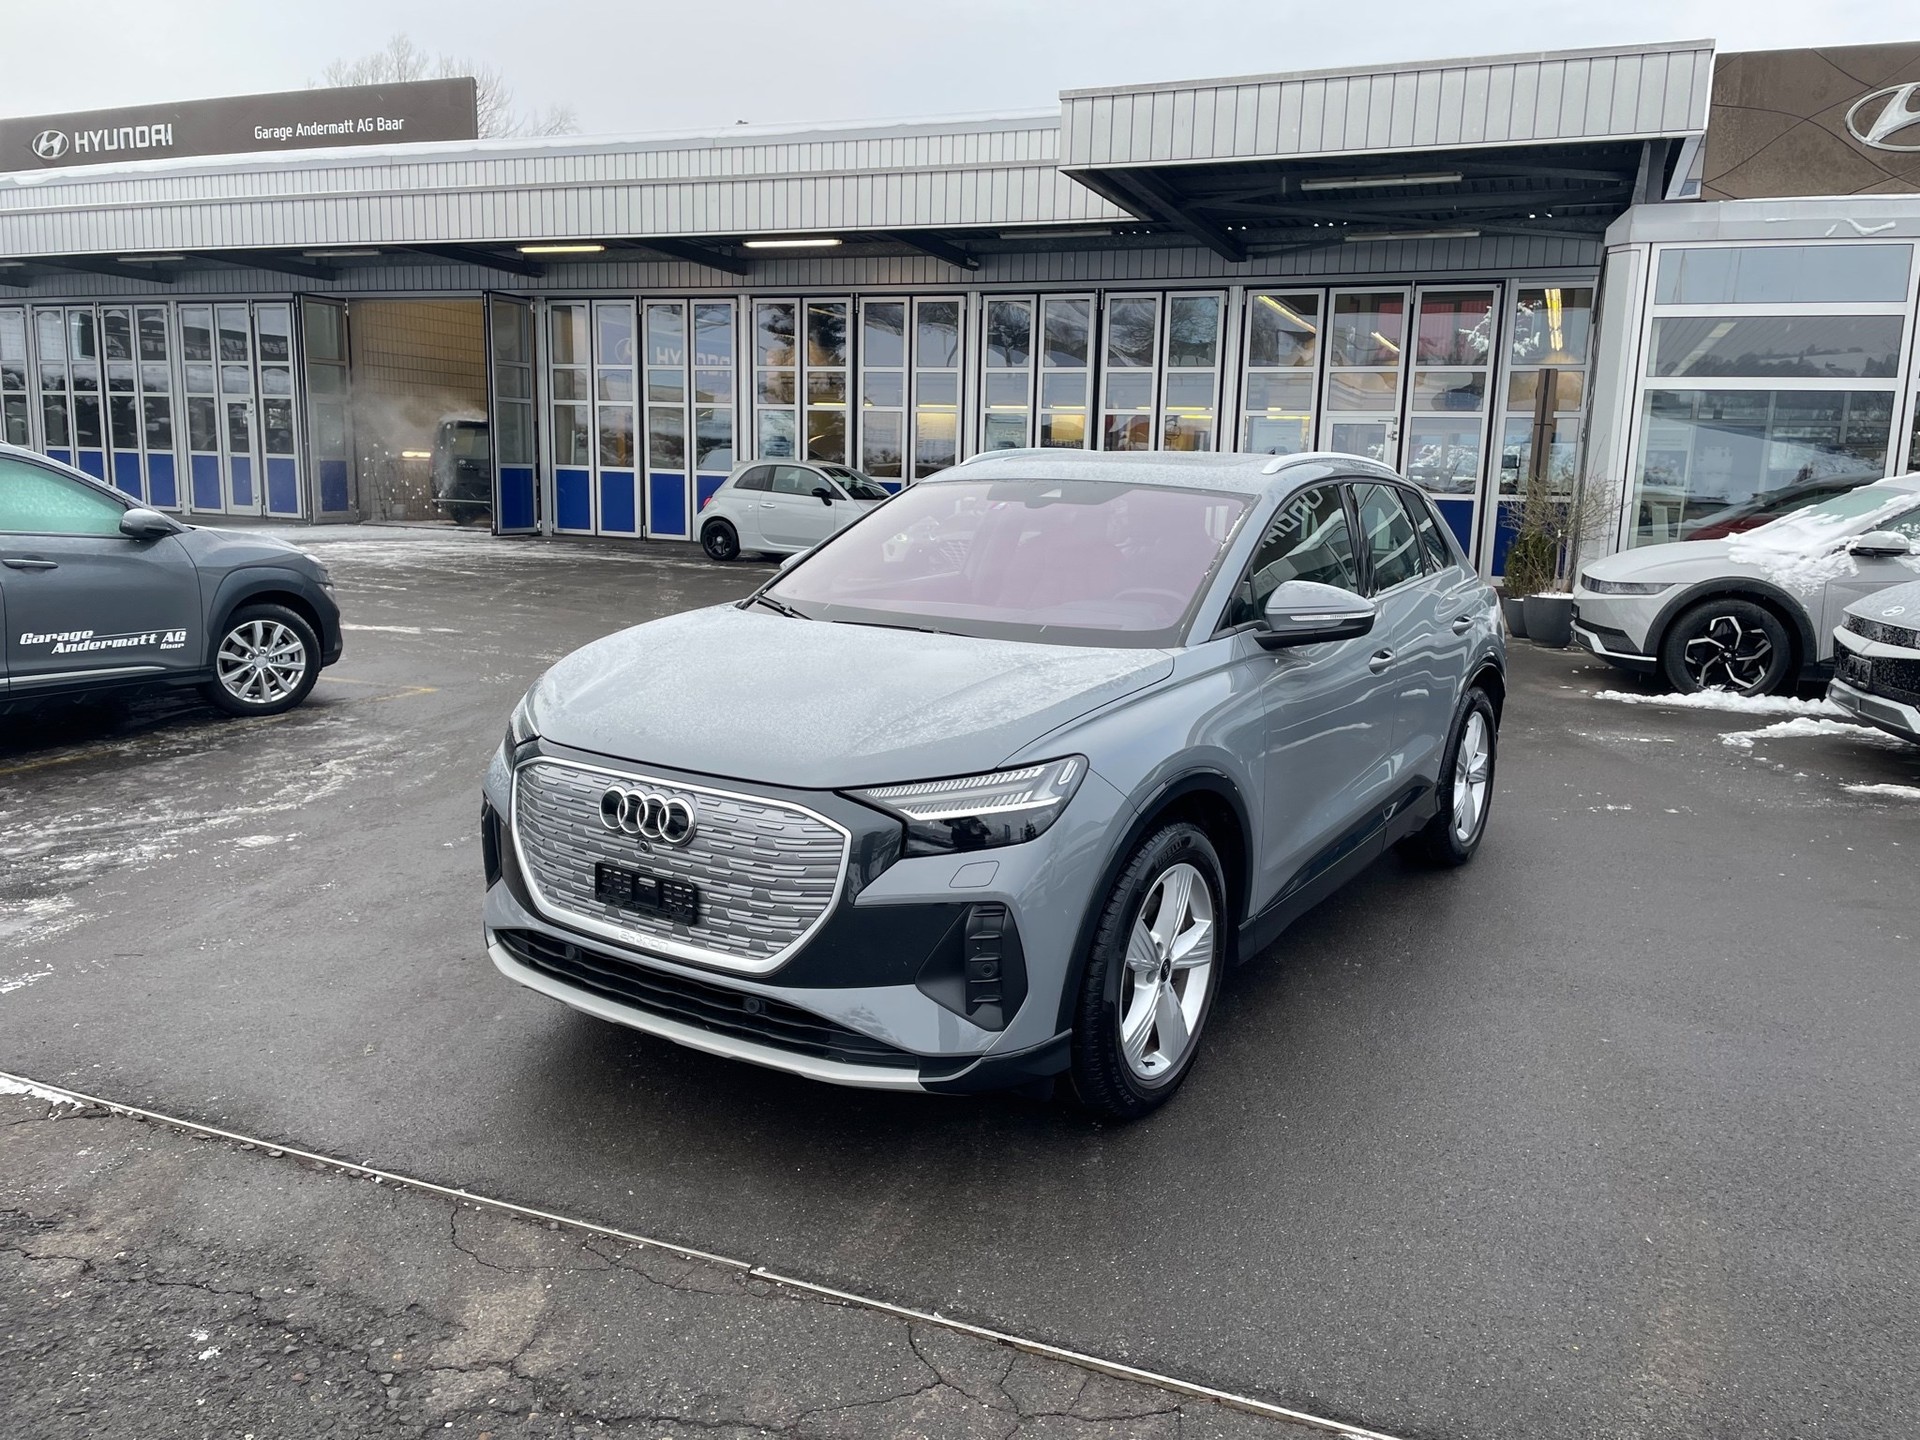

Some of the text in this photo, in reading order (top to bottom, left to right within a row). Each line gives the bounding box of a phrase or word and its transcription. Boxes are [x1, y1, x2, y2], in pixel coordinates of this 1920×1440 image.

[74, 123, 173, 153] HYUNDAI
[254, 116, 405, 141] Garage Andermatt AG Baar
[19, 630, 94, 645] Garage
[51, 631, 187, 654] Andermatt AG
